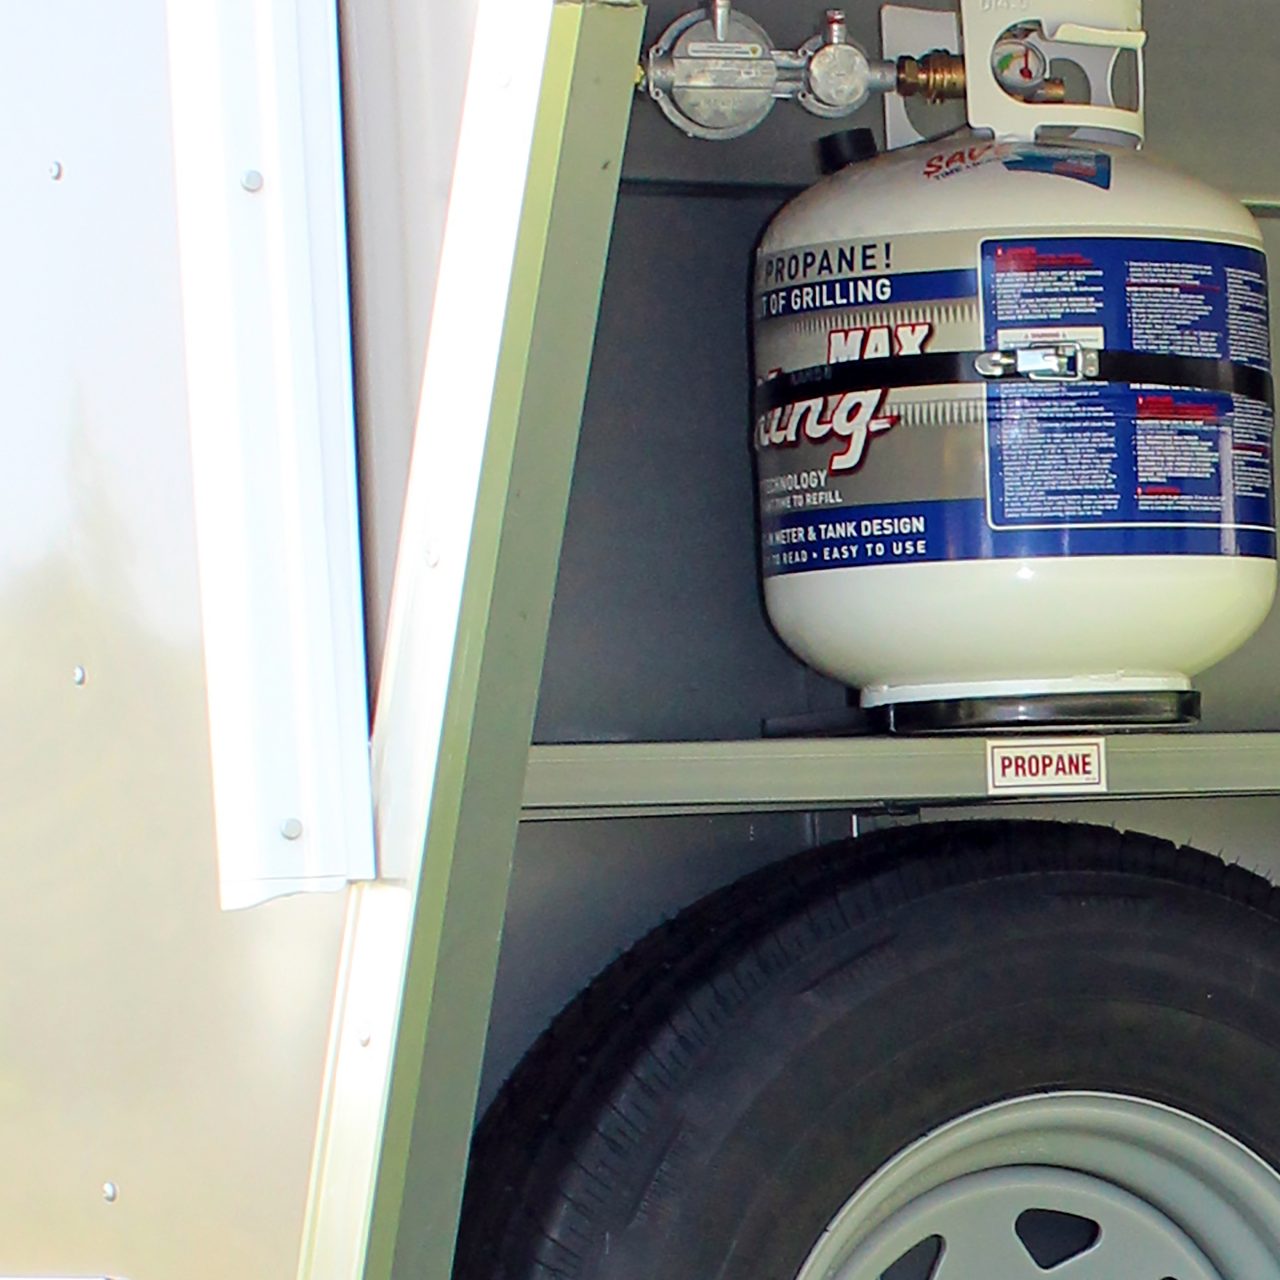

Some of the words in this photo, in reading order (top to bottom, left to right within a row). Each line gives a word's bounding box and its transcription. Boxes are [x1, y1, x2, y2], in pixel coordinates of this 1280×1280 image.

[764, 242, 892, 284] PROPANE!
[769, 291, 787, 315] OF
[790, 278, 892, 310] GRILLING
[828, 321, 933, 365] MAX
[805, 489, 843, 505] REFILL
[807, 526, 817, 542] &
[818, 521, 858, 540] TANK
[860, 516, 925, 537] DESIGN
[782, 550, 808, 565] READ
[823, 545, 859, 561] EASY
[865, 543, 885, 556] TO
[892, 540, 926, 555] USE
[1000, 753, 1092, 777] PROPANE
